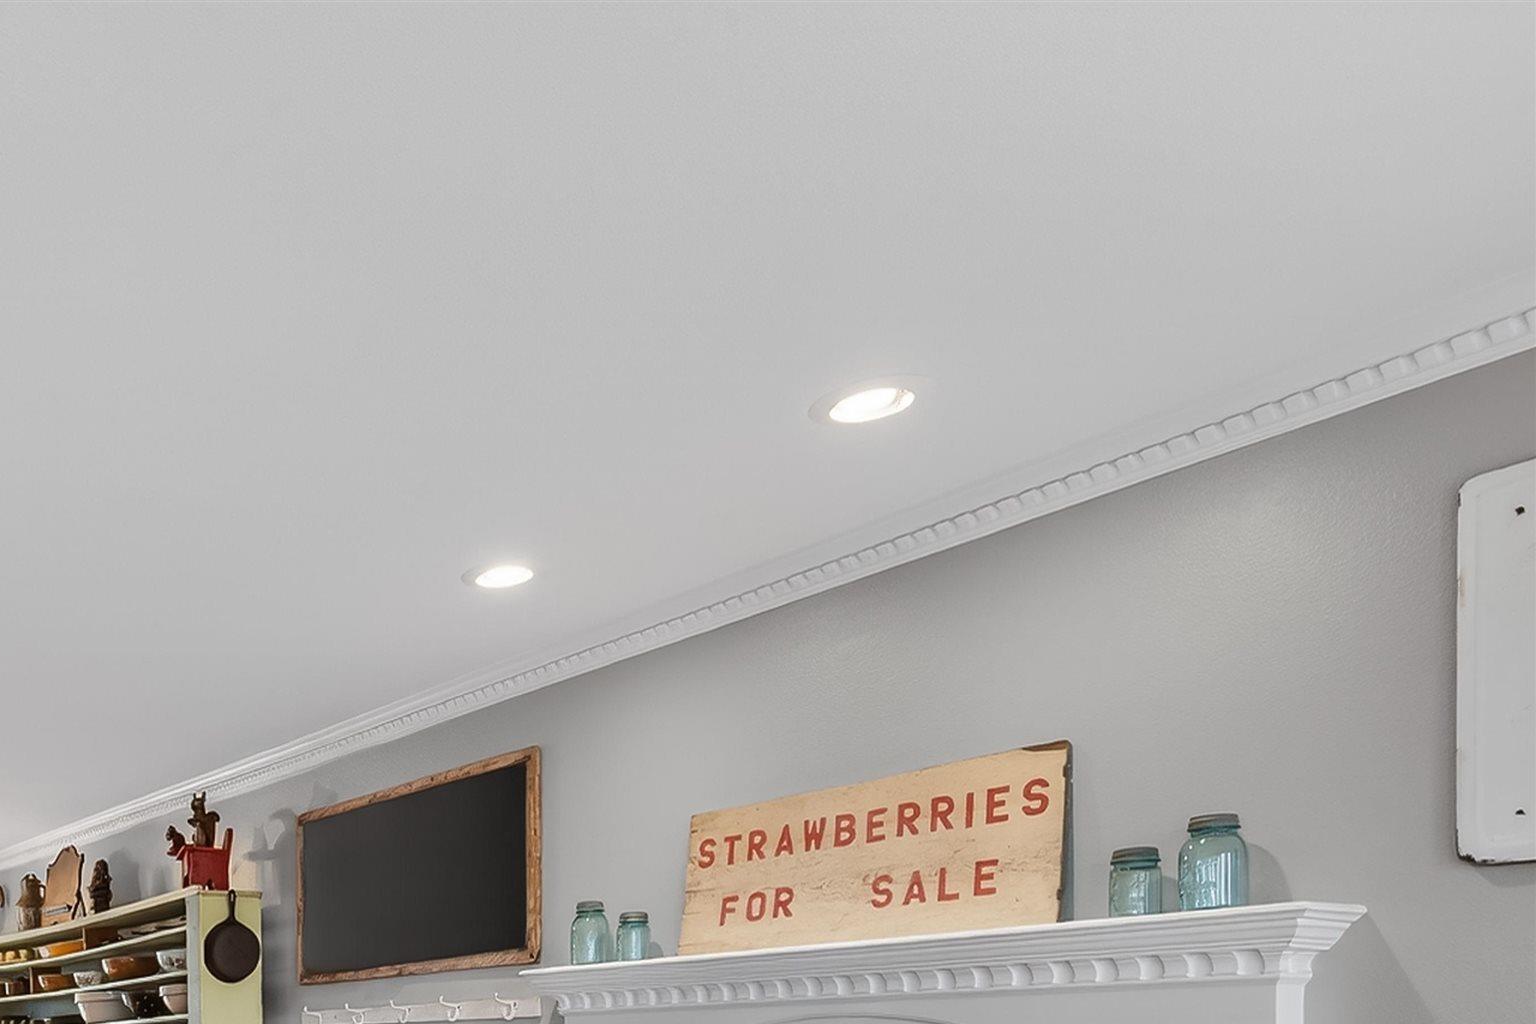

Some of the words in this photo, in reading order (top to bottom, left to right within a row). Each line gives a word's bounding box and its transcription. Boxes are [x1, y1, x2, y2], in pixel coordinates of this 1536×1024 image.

[697, 776, 1050, 869] STRAWBERRIES
[718, 886, 795, 926] FOR
[870, 857, 1000, 909] SALE
